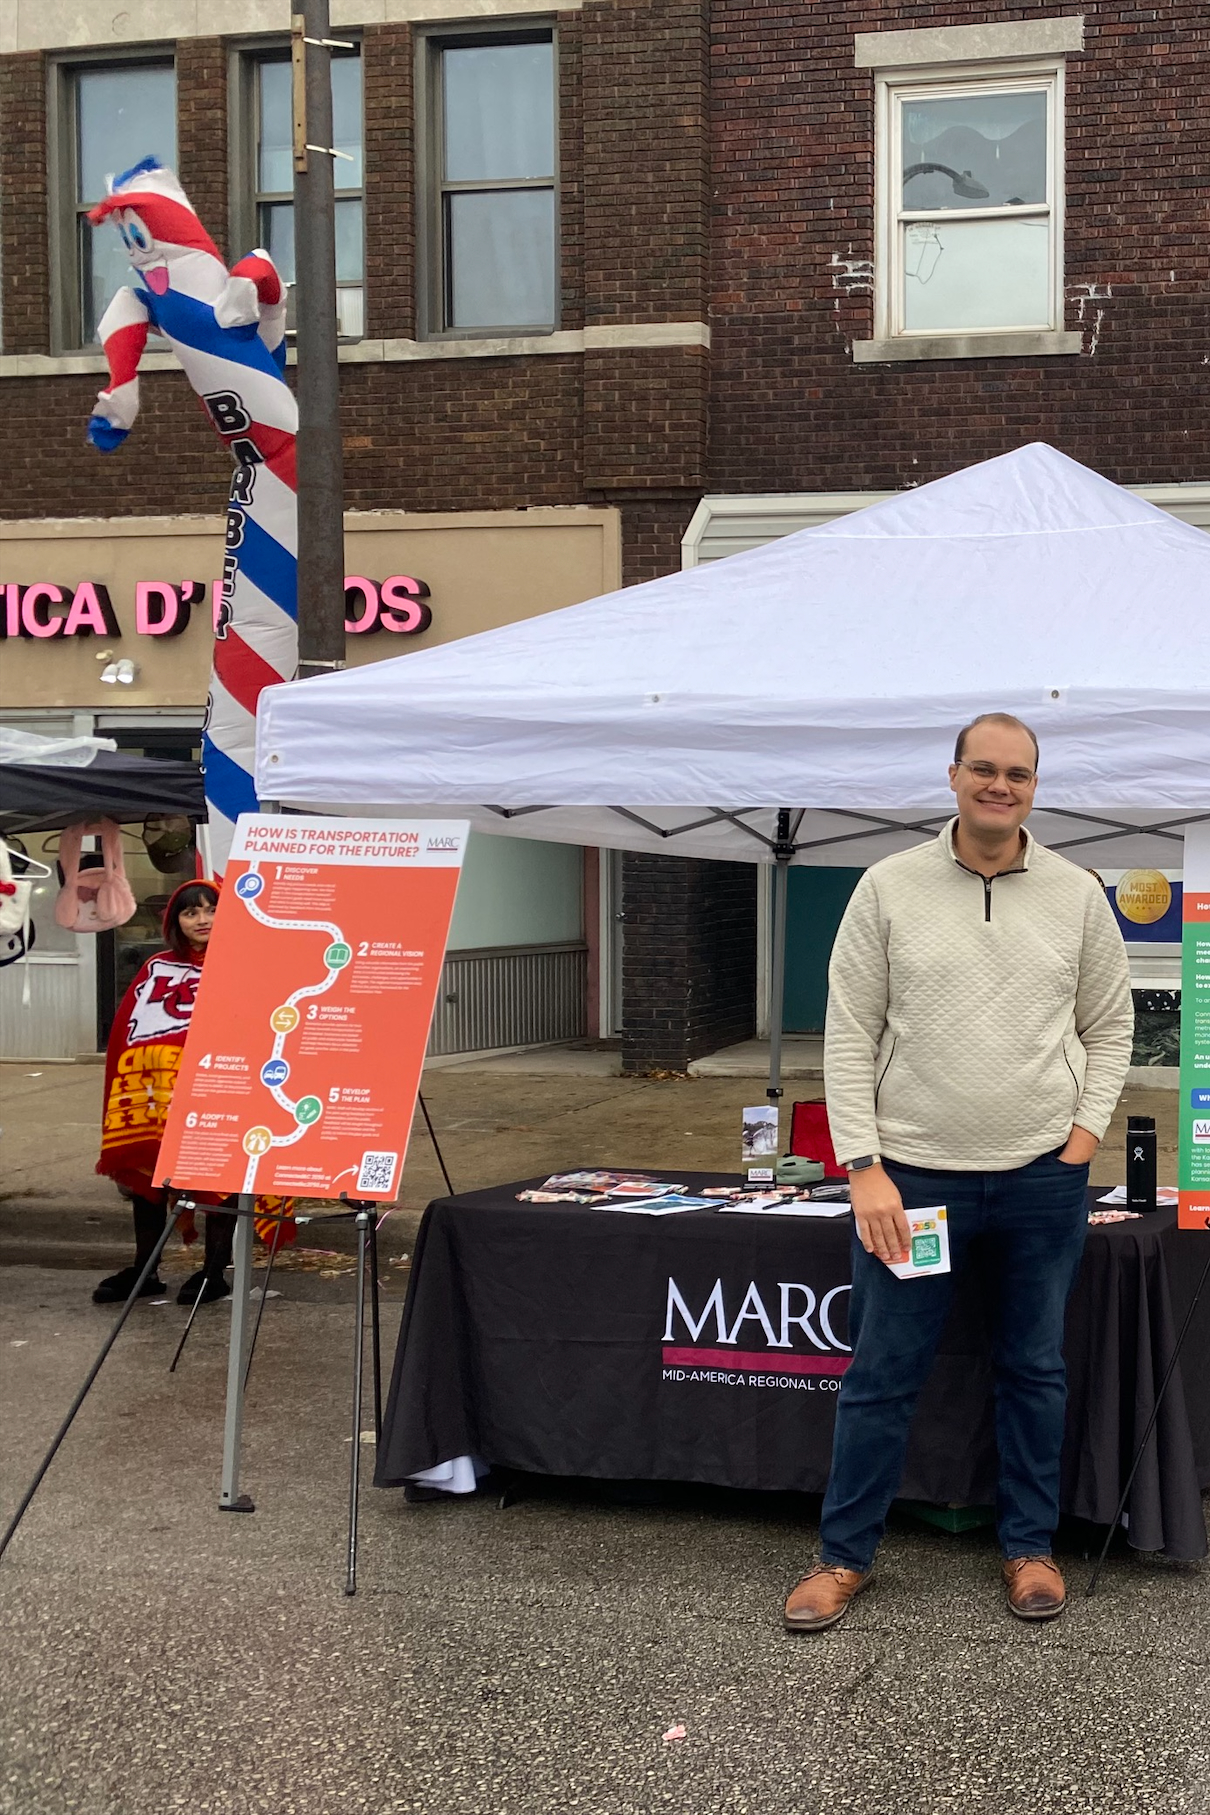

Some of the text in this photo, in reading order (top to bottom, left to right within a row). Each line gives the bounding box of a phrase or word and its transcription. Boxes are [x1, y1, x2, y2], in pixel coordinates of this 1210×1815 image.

[0, 582, 107, 637] ICA
[247, 827, 418, 843] HOW IS TRANSPORTATION
[427, 837, 460, 847] MARC
[244, 841, 419, 858] PLANNED FOR THE FUTURE?
[275, 866, 318, 880] 1 DISCOVER
[1130, 882, 1158, 893] MOST
[1119, 893, 1168, 904] AWARDED
[357, 942, 369, 956] 2
[307, 1005, 318, 1020] 3
[198, 1054, 246, 1069] 4 IDENTIFY
[213, 1063, 249, 1072] PROJECTS
[329, 1088, 340, 1102] 5
[186, 1113, 198, 1128] 6
[200, 1113, 226, 1121] ADOPT
[198, 1120, 218, 1129] PLAN
[661, 1276, 852, 1351] MARC
[662, 1370, 745, 1386] MID-AMERICA
[749, 1375, 815, 1391] REGIONAL
